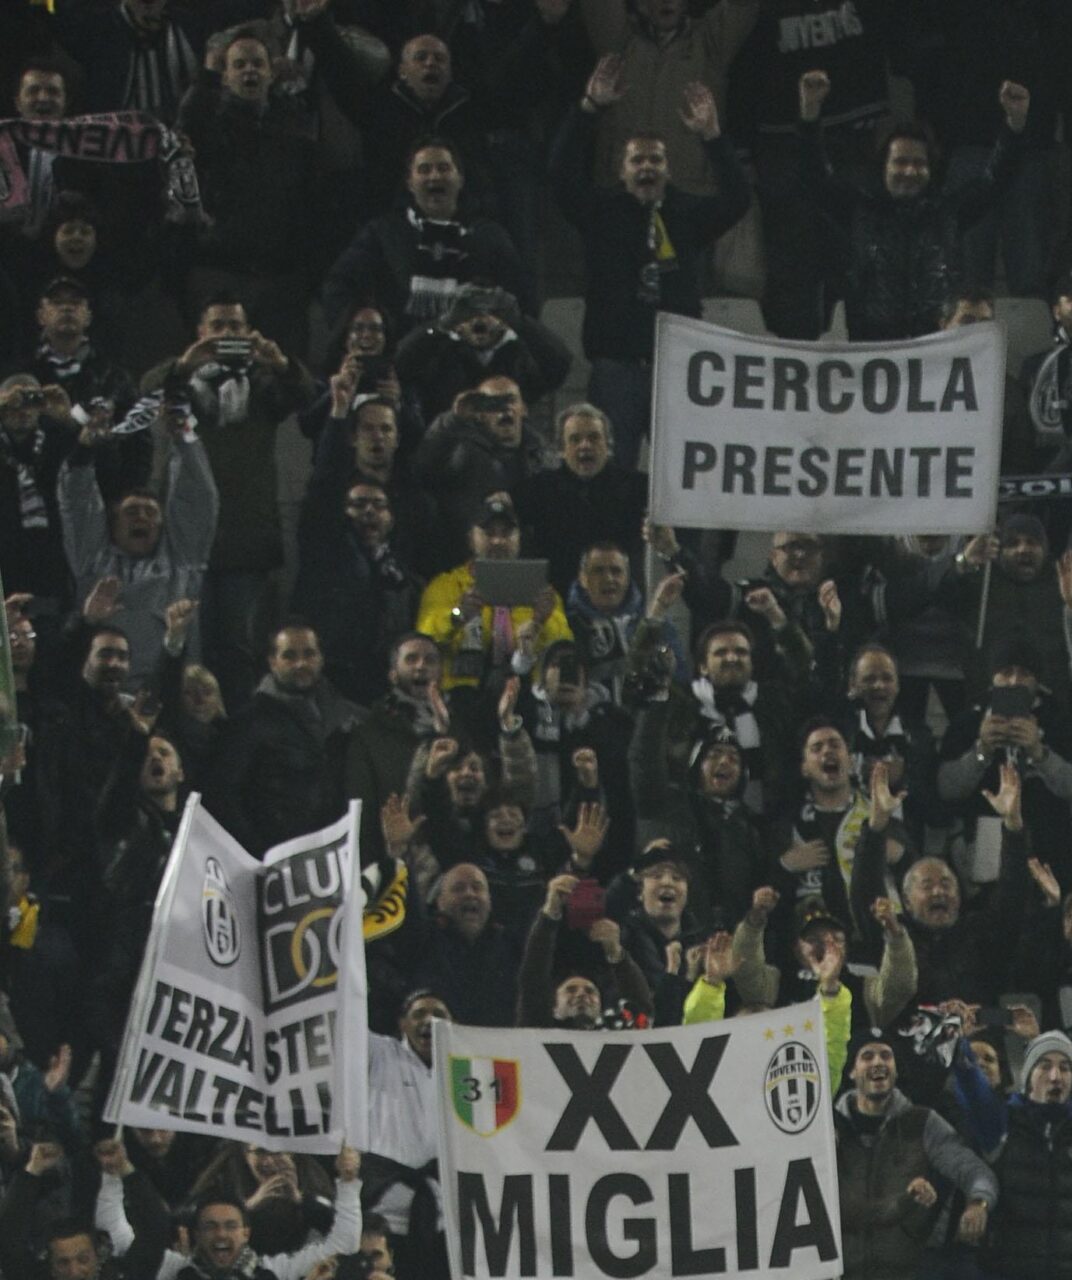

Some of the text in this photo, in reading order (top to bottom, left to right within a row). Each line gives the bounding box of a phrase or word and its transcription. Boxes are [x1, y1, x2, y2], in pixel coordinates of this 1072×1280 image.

[686, 350, 979, 415] CERCOLA
[682, 440, 976, 499] PRESENTE
[147, 980, 335, 1085] TERZA STE
[542, 1033, 740, 1152] XX
[457, 1157, 839, 1280] MIGLIA
